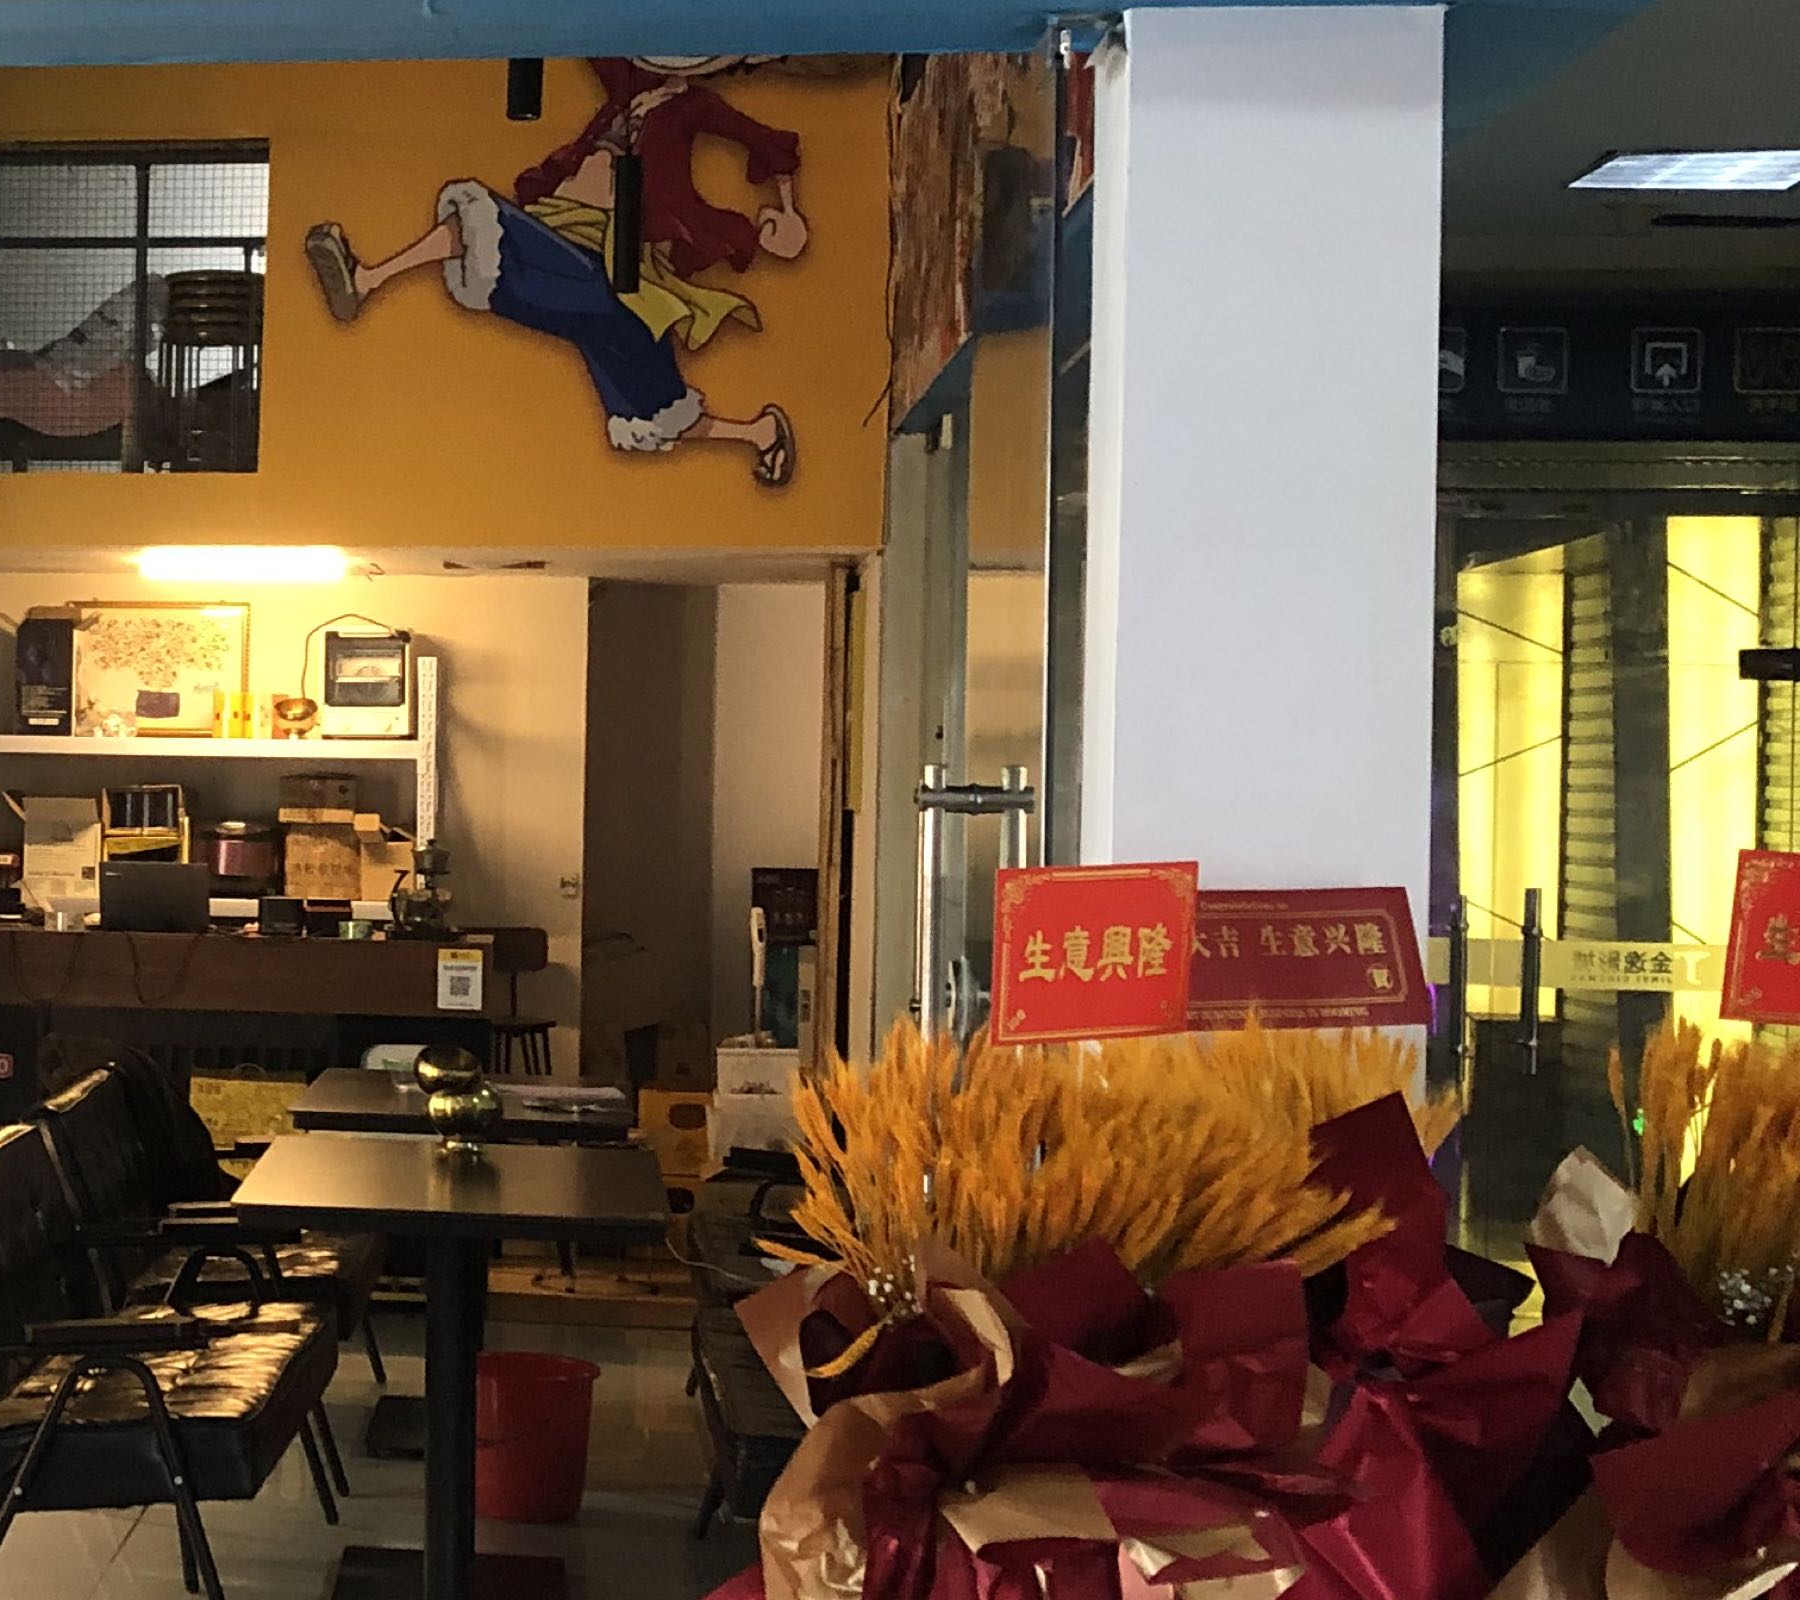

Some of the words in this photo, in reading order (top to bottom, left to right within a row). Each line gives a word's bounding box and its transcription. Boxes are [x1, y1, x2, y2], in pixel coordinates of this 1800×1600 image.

[1018, 922, 1174, 982] 生意興隆
[1258, 922, 1388, 958] 生意兴隆
